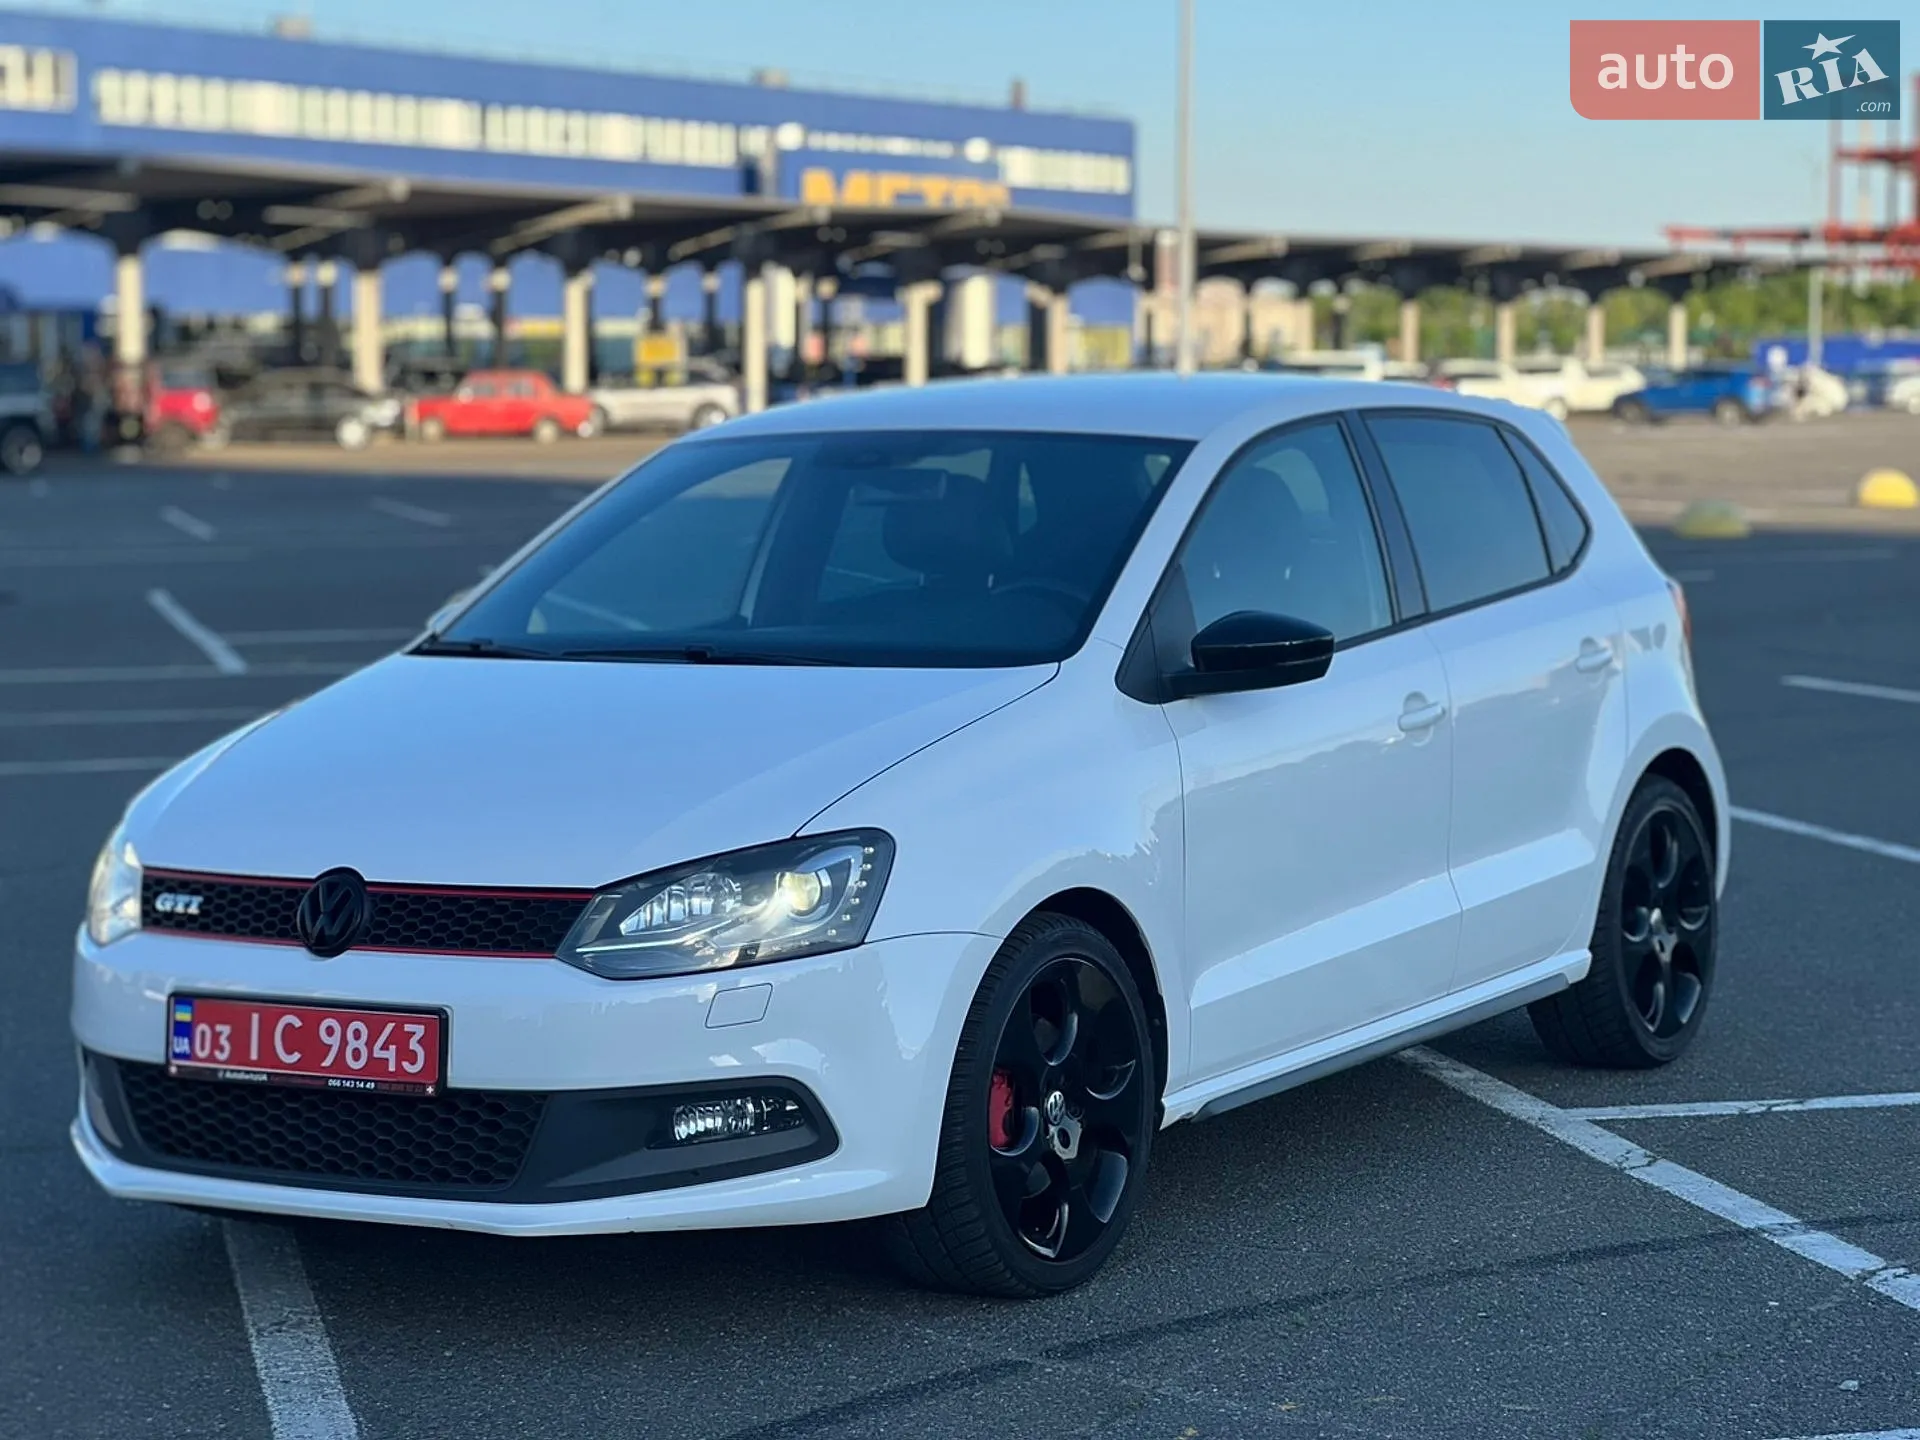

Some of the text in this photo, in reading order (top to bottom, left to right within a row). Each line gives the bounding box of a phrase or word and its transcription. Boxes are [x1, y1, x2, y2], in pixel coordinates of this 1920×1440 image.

[154, 892, 204, 915] GTI
[173, 1035, 191, 1055] UA
[194, 1012, 426, 1074] 03 IC 9843
[327, 1078, 341, 1088] 066
